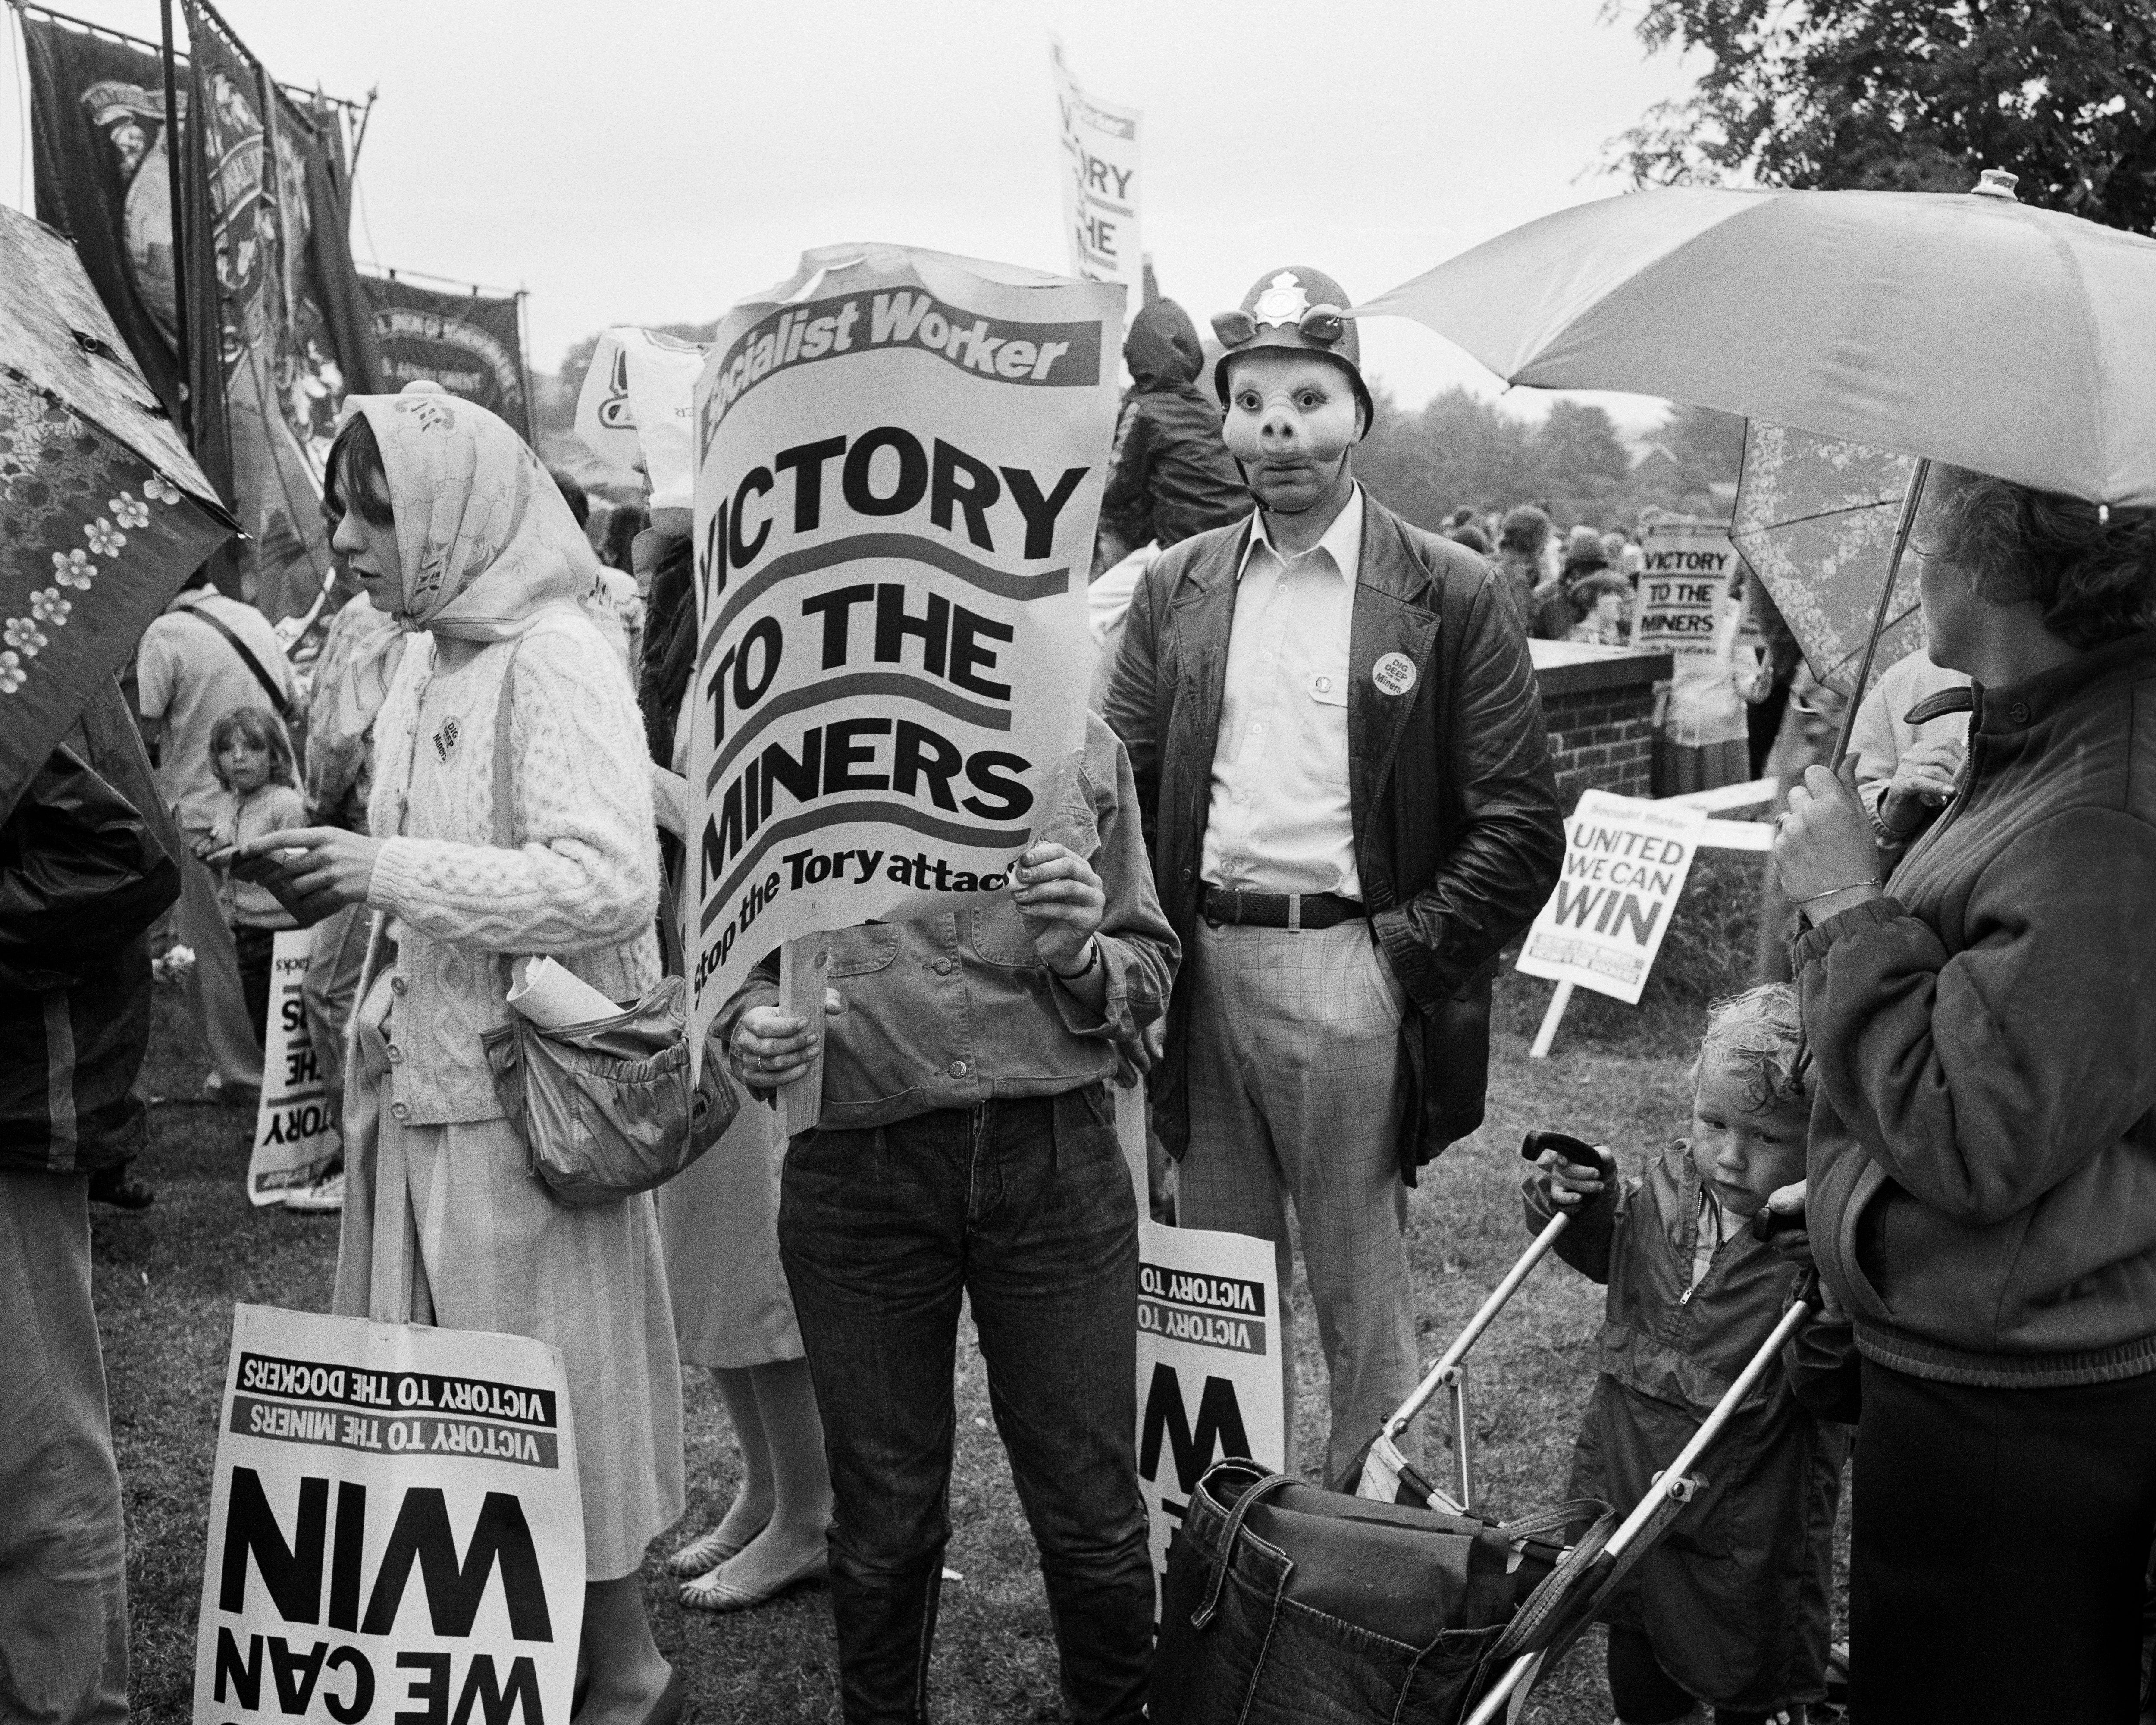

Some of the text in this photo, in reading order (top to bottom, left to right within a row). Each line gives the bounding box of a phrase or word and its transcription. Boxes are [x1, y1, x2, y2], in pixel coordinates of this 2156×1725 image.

[870, 291, 1070, 381] Worker
[699, 426, 1091, 625] VICTORY
[1643, 551, 1728, 571] VICTORY
[1649, 583, 1715, 603] TO THE
[1640, 613, 1714, 632] MINERS
[706, 583, 1015, 751] TO THE
[1374, 672, 1403, 694] Miners
[1385, 664, 1408, 679] DEEP
[1392, 658, 1408, 672] DIG
[432, 732, 446, 761] Miners
[448, 722, 458, 739] DIG
[700, 718, 1034, 906] MINERS
[1573, 822, 1685, 865] UNITED
[1567, 852, 1675, 897] WE CAN
[693, 921, 736, 1012] Stop
[739, 871, 780, 933] the
[782, 846, 886, 892] Tory
[1555, 880, 1664, 947] WIN
[1141, 1267, 1256, 1311] VICTORY TO
[1137, 1304, 1251, 1349] VICTORY TO
[243, 1358, 546, 1422] VICTORY TO THE DOCKERS
[249, 1403, 541, 1462] VICTORY TO THE MINERS
[219, 1465, 555, 1643] WIN
[213, 1625, 545, 1725] WE CAN
